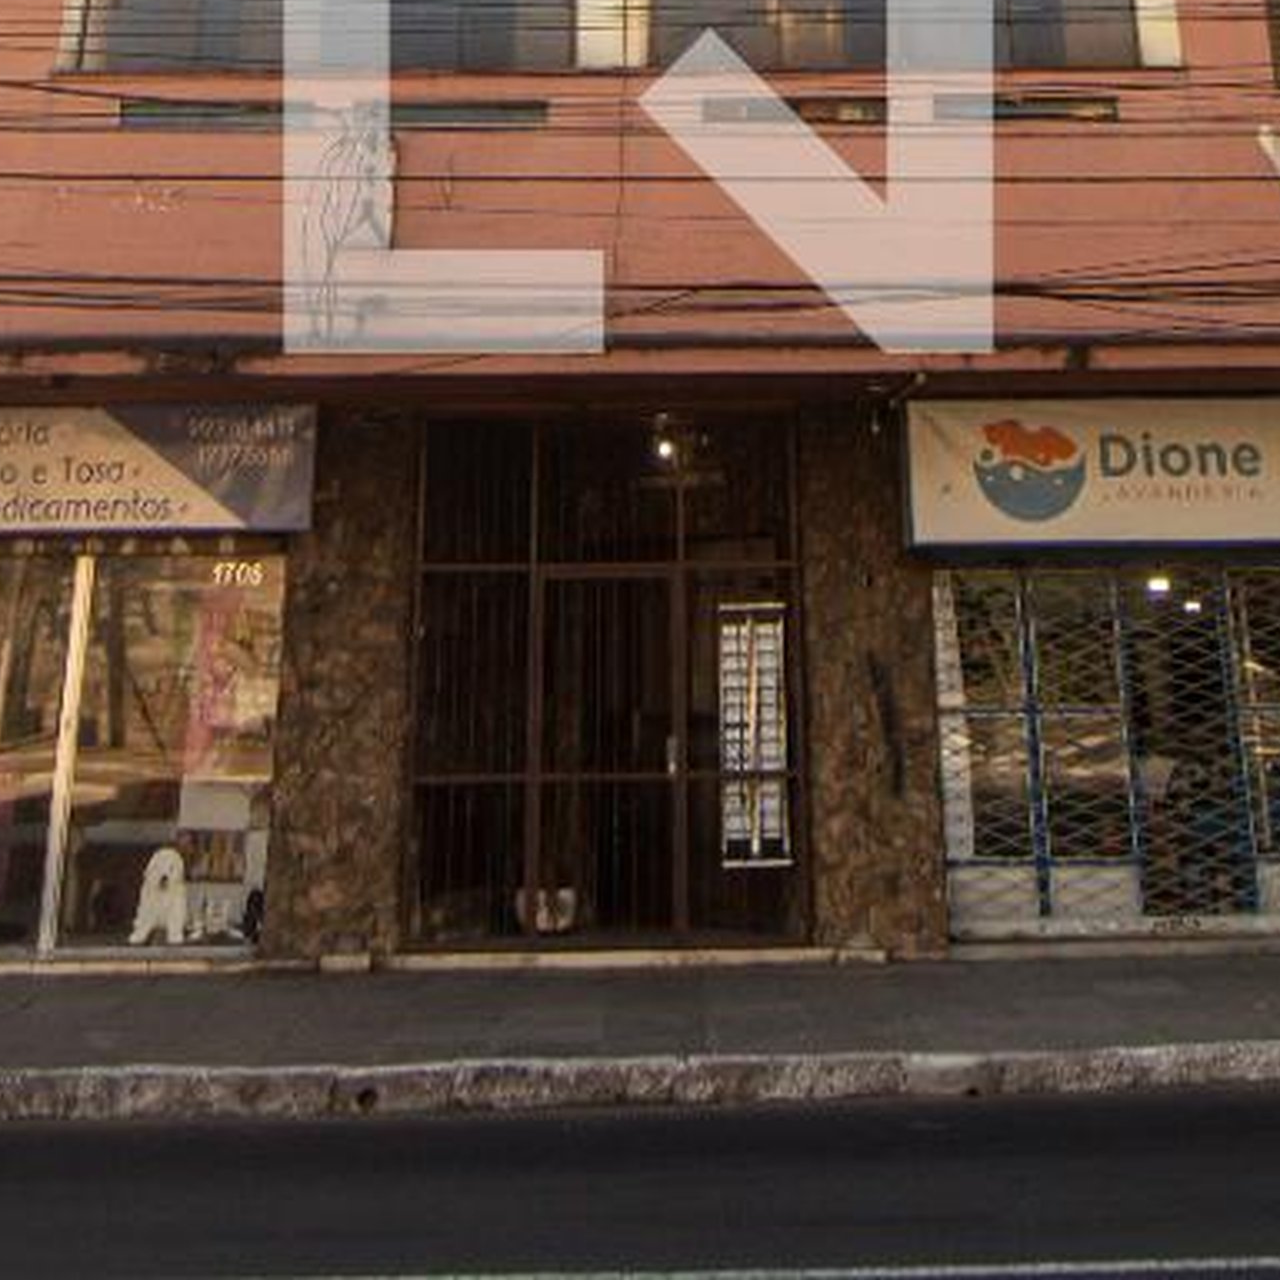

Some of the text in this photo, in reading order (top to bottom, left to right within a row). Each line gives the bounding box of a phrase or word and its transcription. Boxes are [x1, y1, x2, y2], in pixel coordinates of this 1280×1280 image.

[31, 465, 48, 484] e
[61, 457, 126, 484] Tosa
[1098, 431, 1263, 478] Dione
